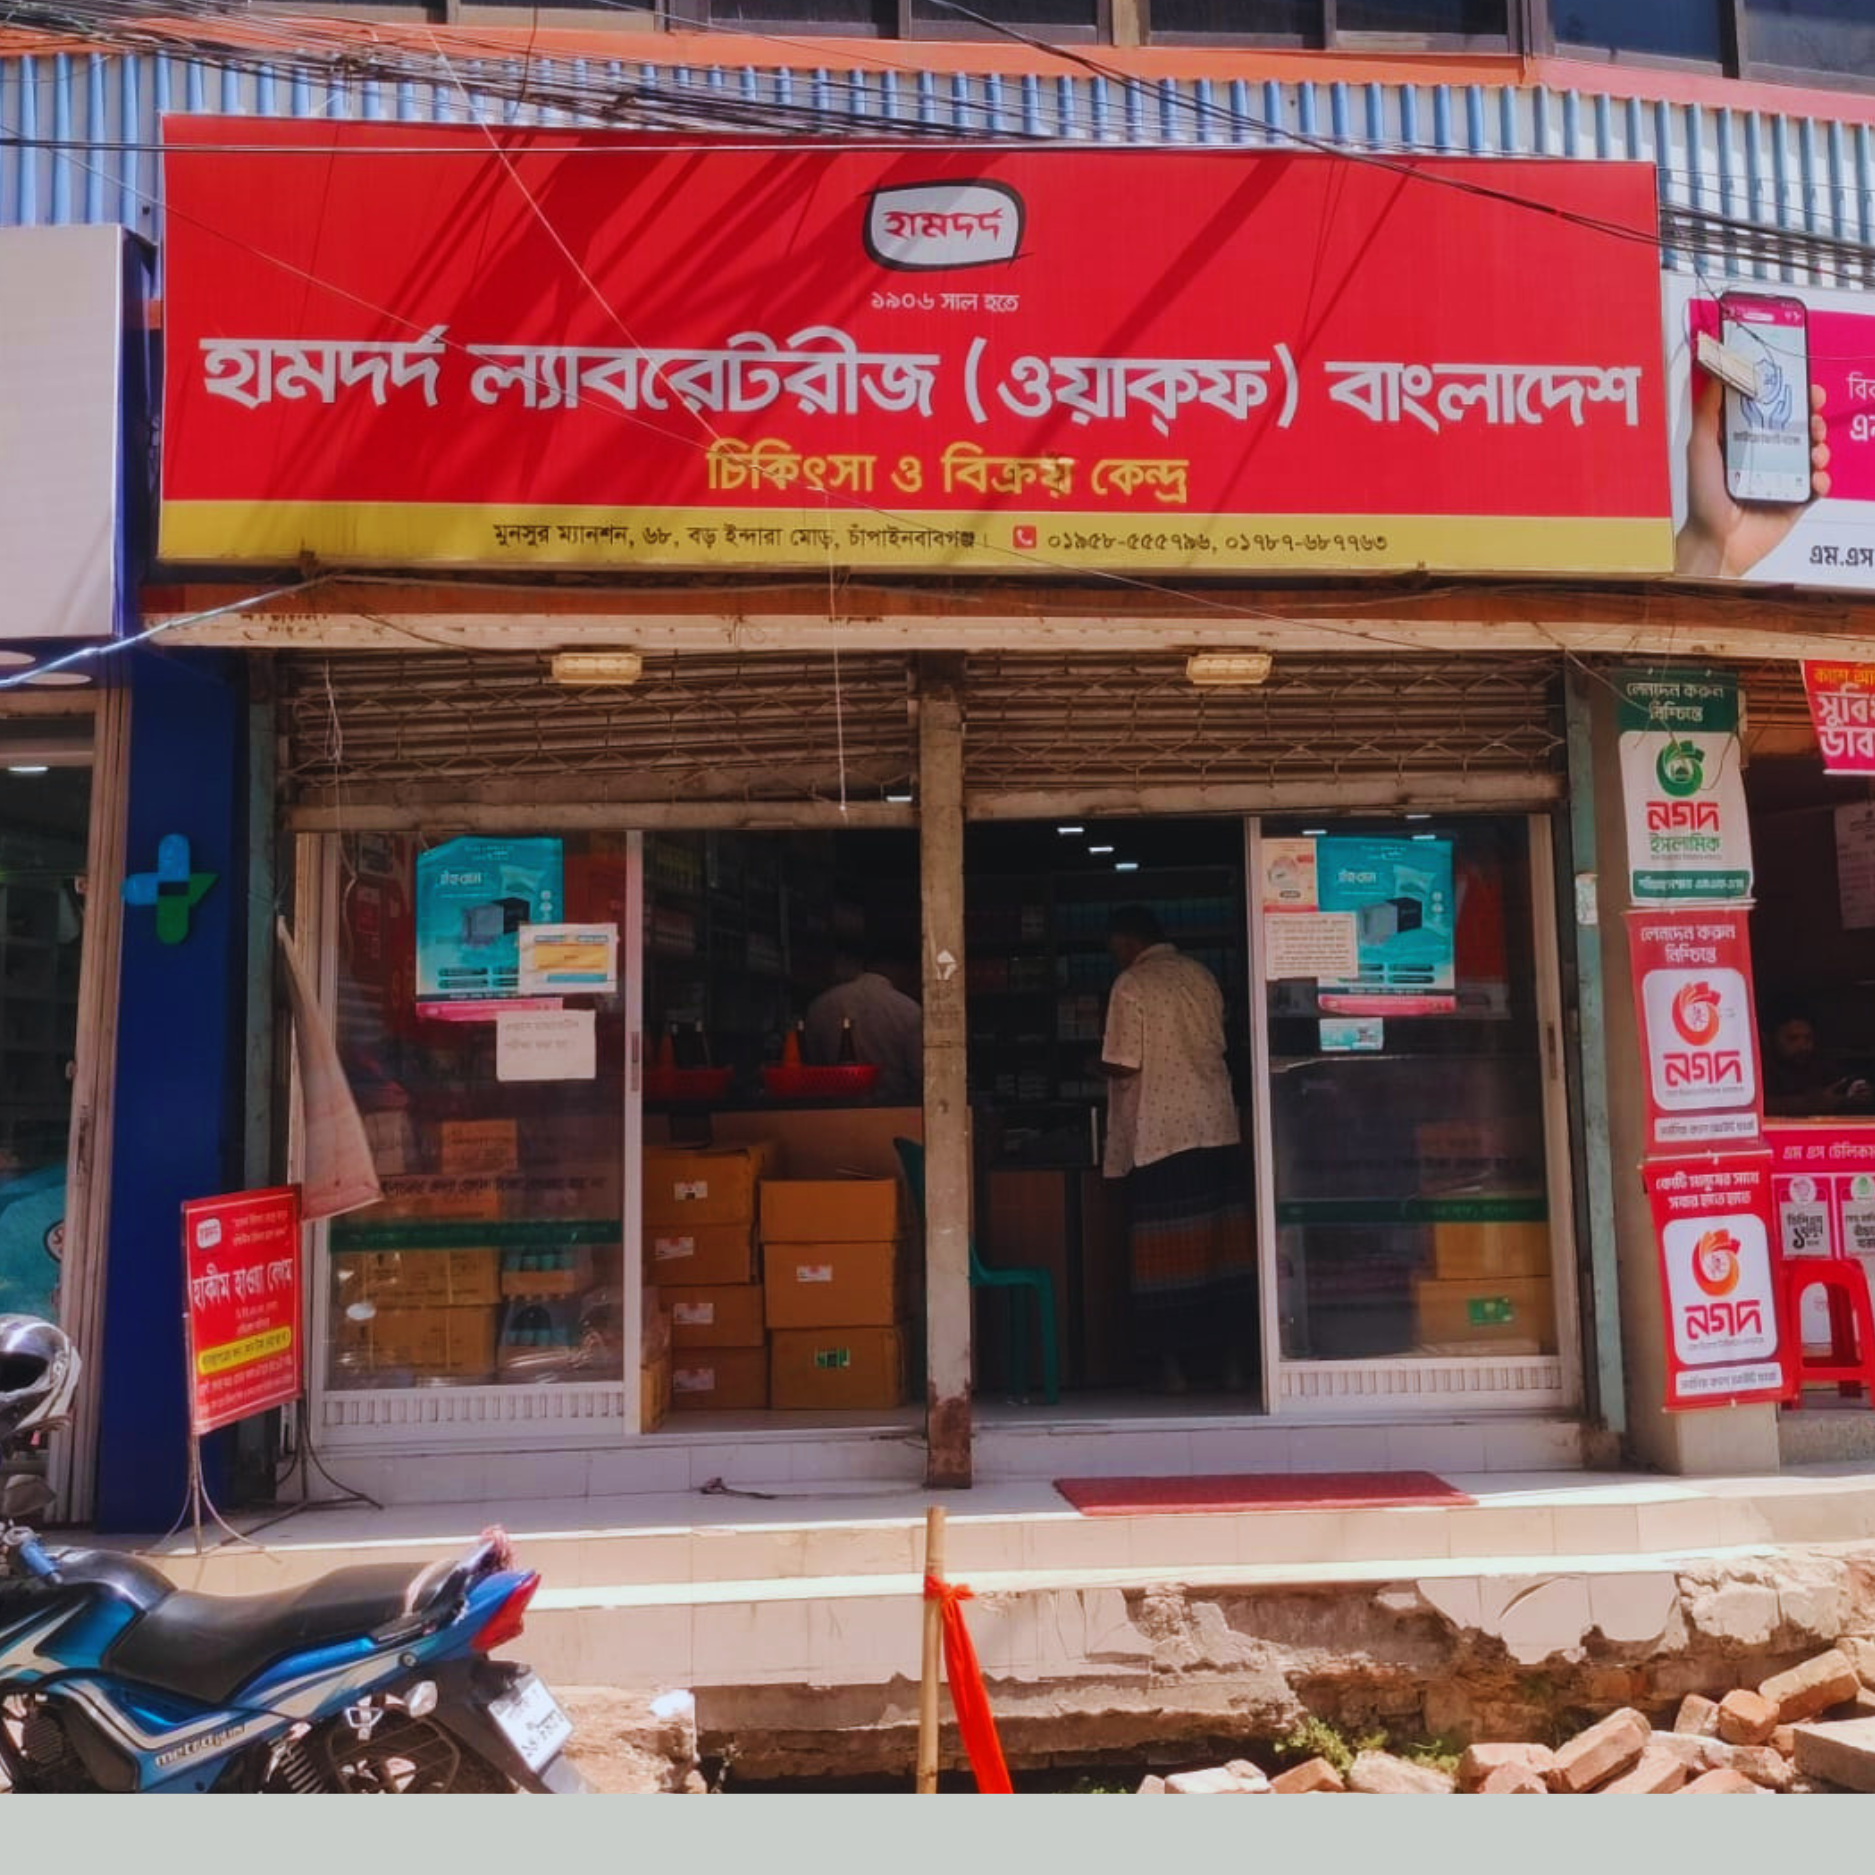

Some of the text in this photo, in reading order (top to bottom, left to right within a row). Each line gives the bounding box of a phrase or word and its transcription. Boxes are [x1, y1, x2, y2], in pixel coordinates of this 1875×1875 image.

[883, 207, 1004, 241] হামদর্দ
[871, 291, 1020, 312] ১৯০৬ সাল হতে
[200, 324, 447, 408] হামদর্দ
[467, 326, 939, 418] ল্যাবরেটরীজ
[1326, 360, 1642, 433] বাংলাদেশ
[1845, 371, 1875, 401] বি
[707, 437, 1189, 503] চিকিৎসা ও বিক্রয় কেন্দ্র
[557, 525, 634, 548] ম্যানশন,
[642, 529, 679, 548] ৬৮,
[688, 527, 717, 547] বড়
[724, 524, 781, 547] ইন্দারা
[790, 527, 840, 549] মোড়,
[1048, 531, 1218, 554] ০১৯৫৮-৫৫৫৭৯৬,
[1226, 533, 1389, 553] ০১৭৮৭-৬৮৭৭৬৩
[1646, 801, 1719, 832] নগদ
[1650, 833, 1722, 853] ইসলামিক
[1641, 924, 1736, 942] লেনদেন করুন
[1663, 1050, 1743, 1087] নগদ
[1684, 1299, 1763, 1340] নগদ
